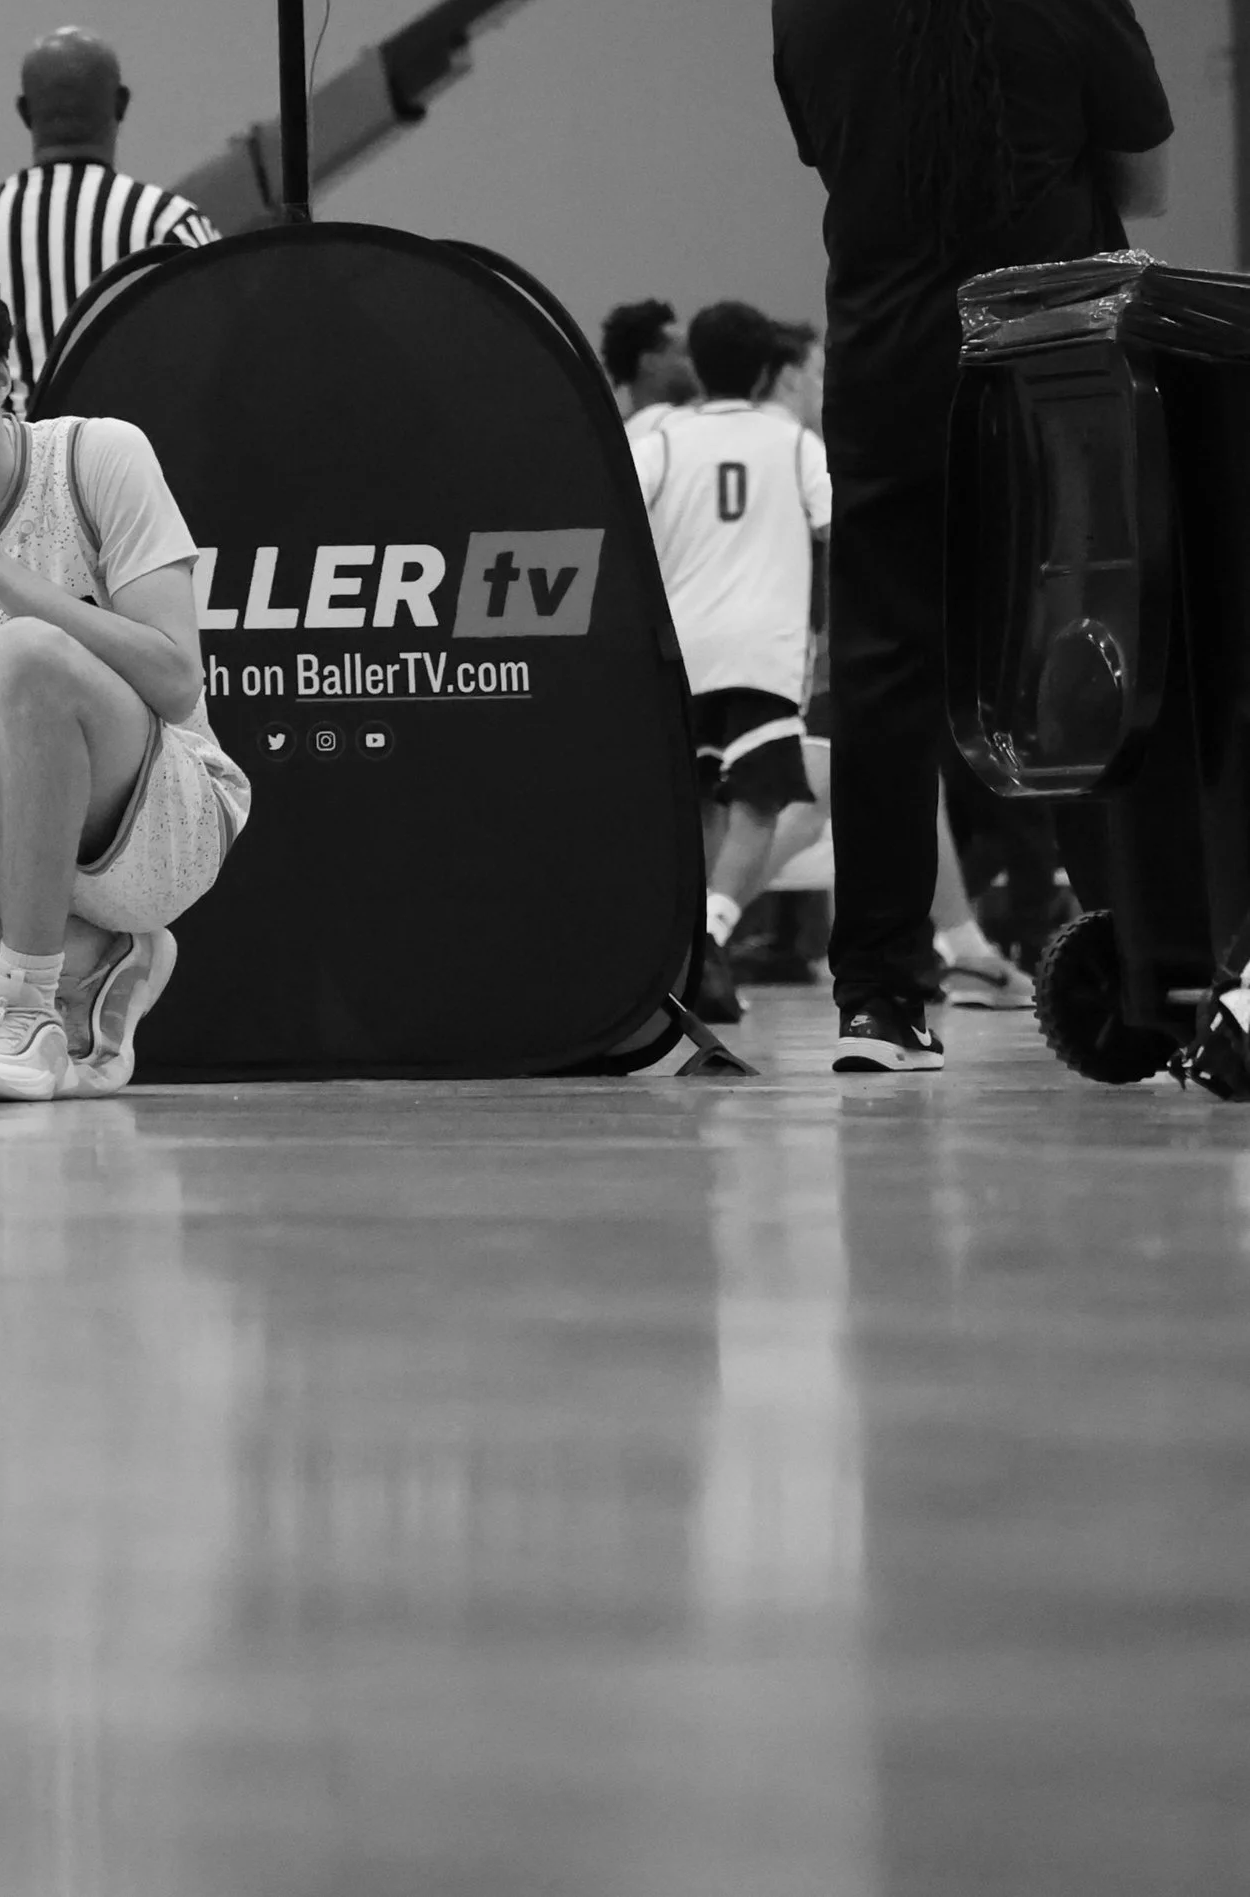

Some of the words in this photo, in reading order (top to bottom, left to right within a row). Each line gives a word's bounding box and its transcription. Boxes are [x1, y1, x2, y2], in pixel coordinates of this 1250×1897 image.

[716, 461, 747, 523] 0
[191, 544, 447, 630] LLER
[482, 551, 579, 618] tv
[242, 665, 284, 696] on
[296, 652, 530, 696] BallerTV.com
